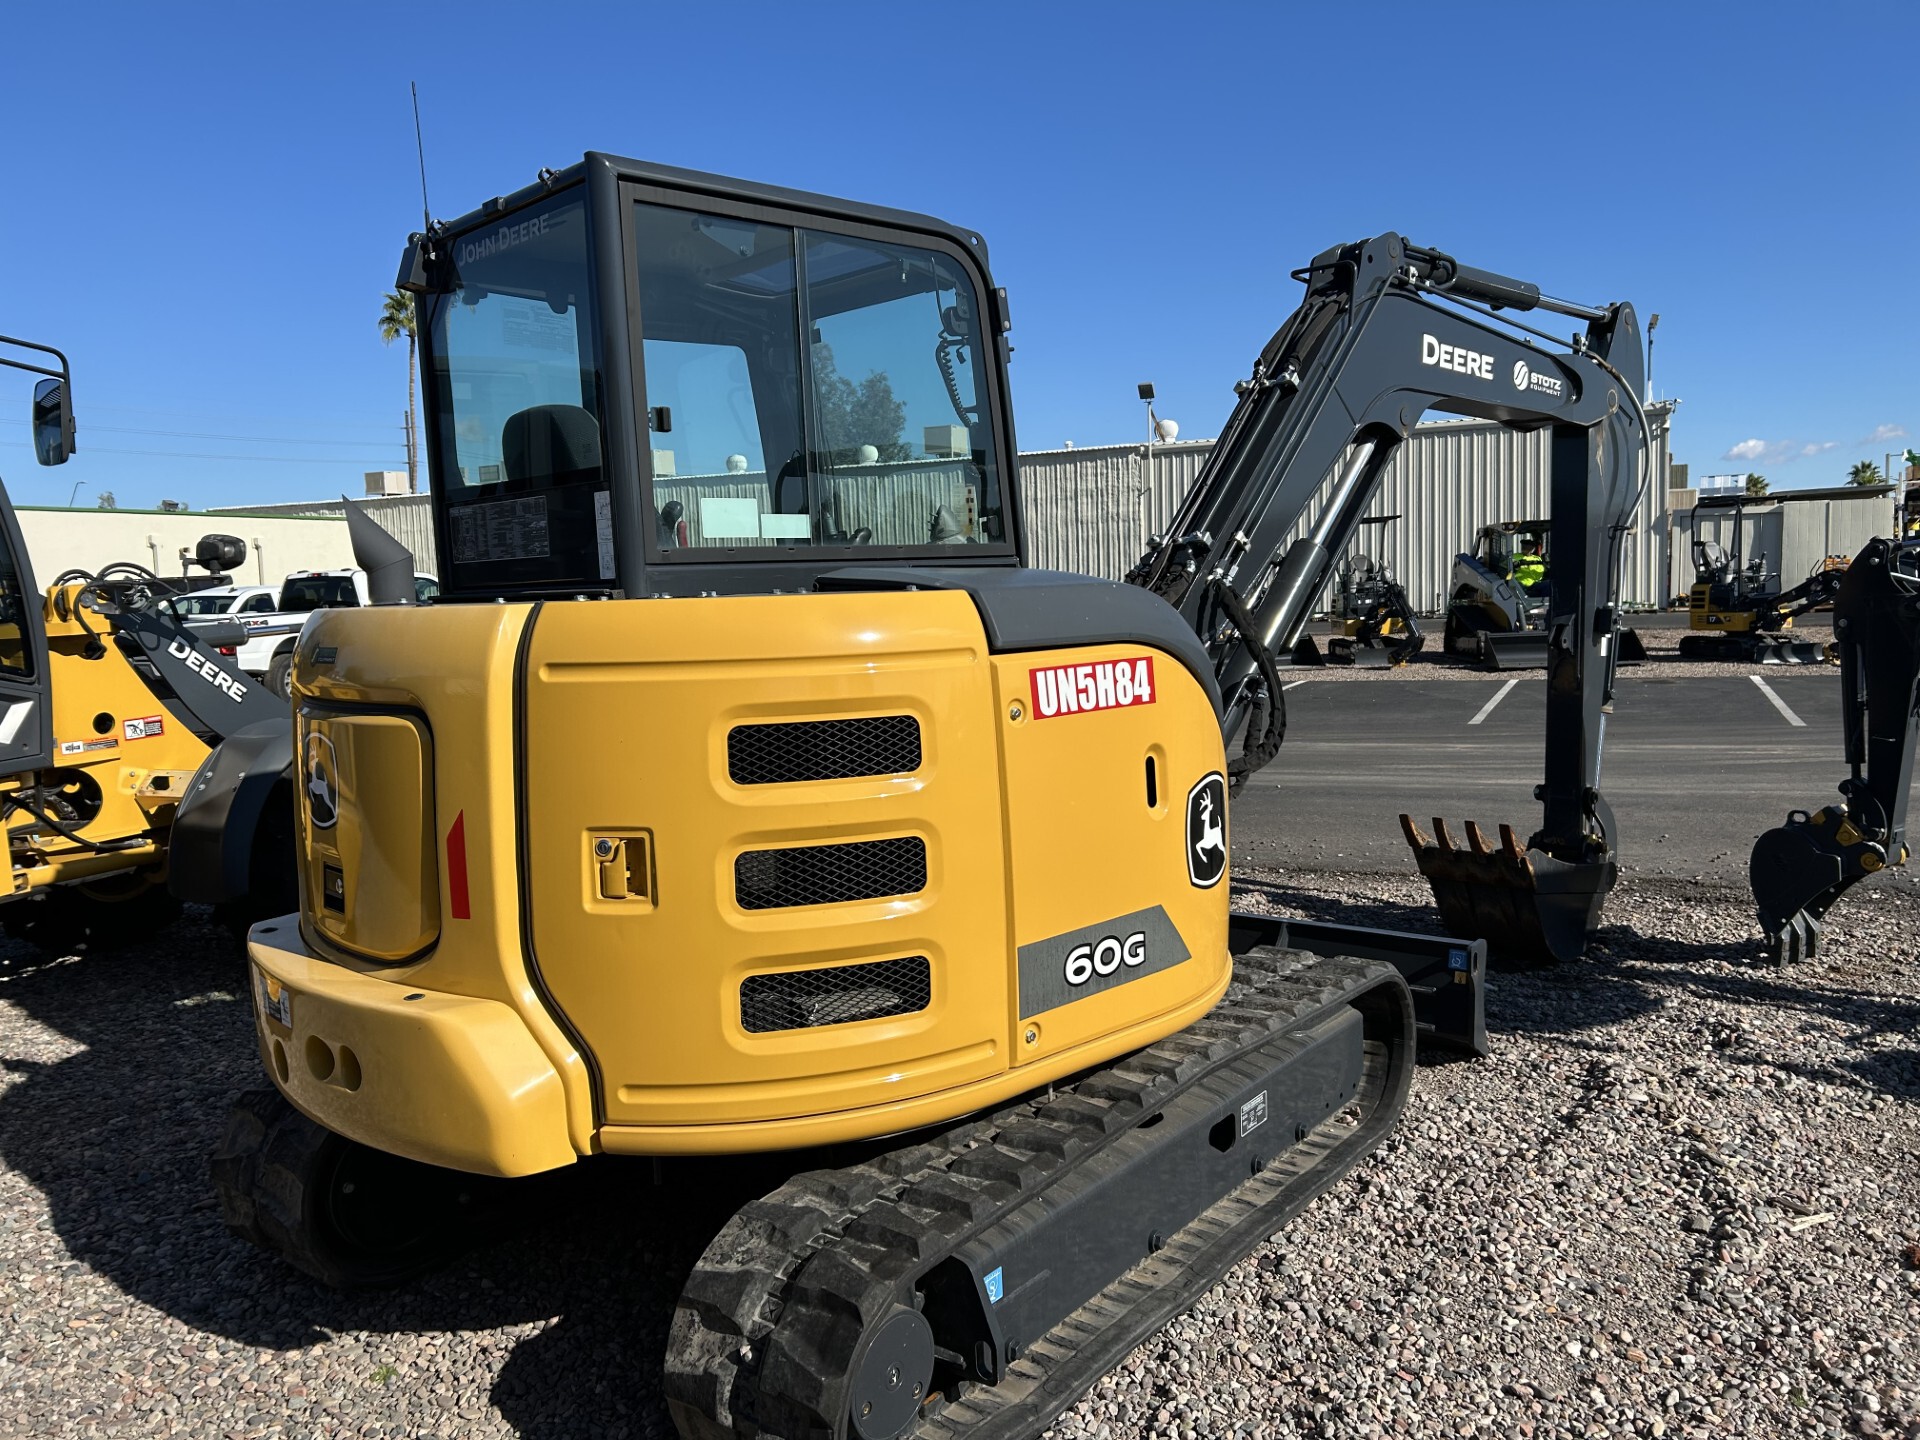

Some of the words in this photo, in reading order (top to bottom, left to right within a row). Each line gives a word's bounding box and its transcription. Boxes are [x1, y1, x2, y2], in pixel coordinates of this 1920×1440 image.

[458, 235, 496, 267] JOHN
[498, 213, 551, 250] DEERE
[1422, 333, 1495, 380] DEERE
[1530, 372, 1562, 390] STOTZ
[1530, 383, 1561, 397] EQUIPMENT
[167, 635, 248, 703] DEERE
[1035, 659, 1151, 716] UN5H84
[1063, 930, 1146, 988] 60G
